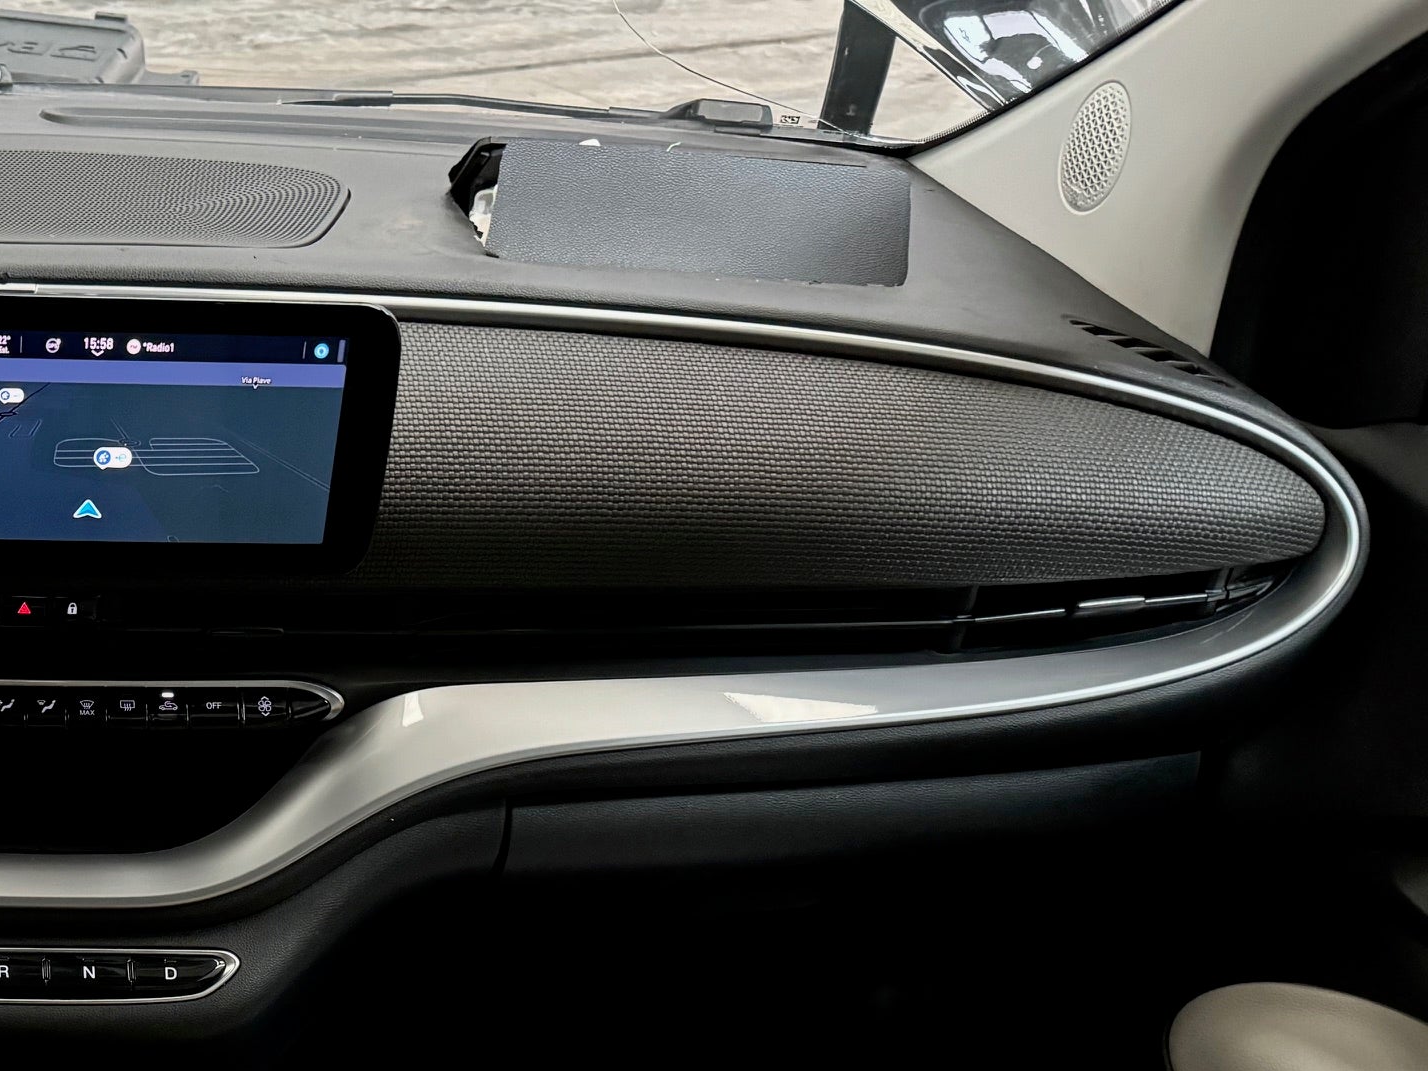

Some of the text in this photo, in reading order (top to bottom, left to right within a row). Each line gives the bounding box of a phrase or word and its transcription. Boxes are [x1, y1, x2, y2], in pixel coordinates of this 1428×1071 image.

[84, 337, 114, 350] 15:58
[253, 377, 271, 385] Piave
[206, 701, 222, 709] OFF
[82, 966, 97, 980] N
[165, 967, 178, 981] D
